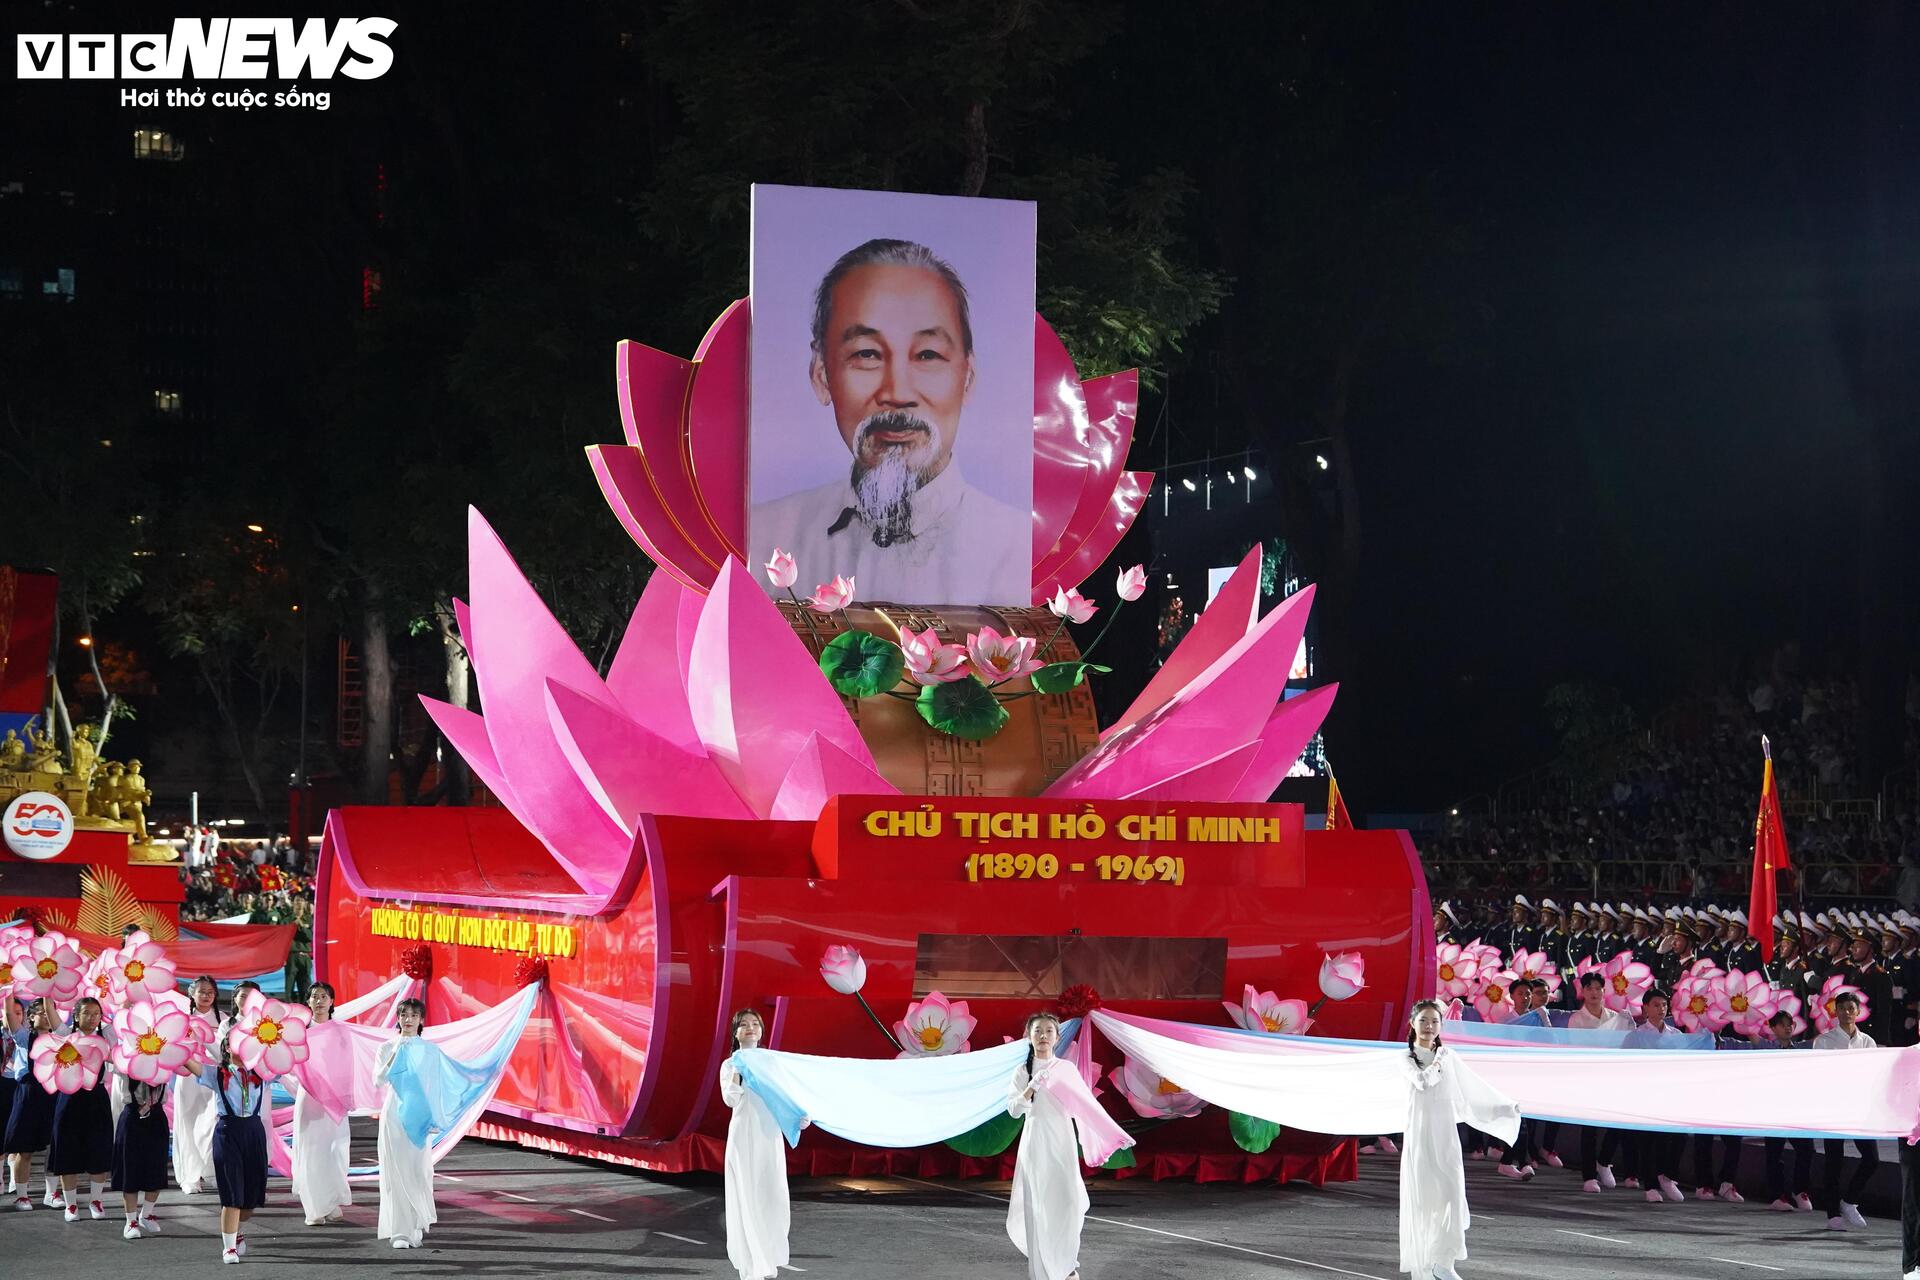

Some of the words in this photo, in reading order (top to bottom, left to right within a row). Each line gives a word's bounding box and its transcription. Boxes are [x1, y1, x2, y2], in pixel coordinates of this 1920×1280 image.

[864, 804, 942, 837] CHỦ
[953, 811, 1039, 844] TỊCH
[1049, 803, 1106, 840] HỒ
[1117, 809, 1177, 841] CHÍ
[1187, 816, 1281, 843] MINH
[965, 852, 1059, 882] (1890
[1095, 854, 1185, 886] 1969)
[371, 904, 405, 939] KHÔNG
[554, 926, 575, 958] DO
